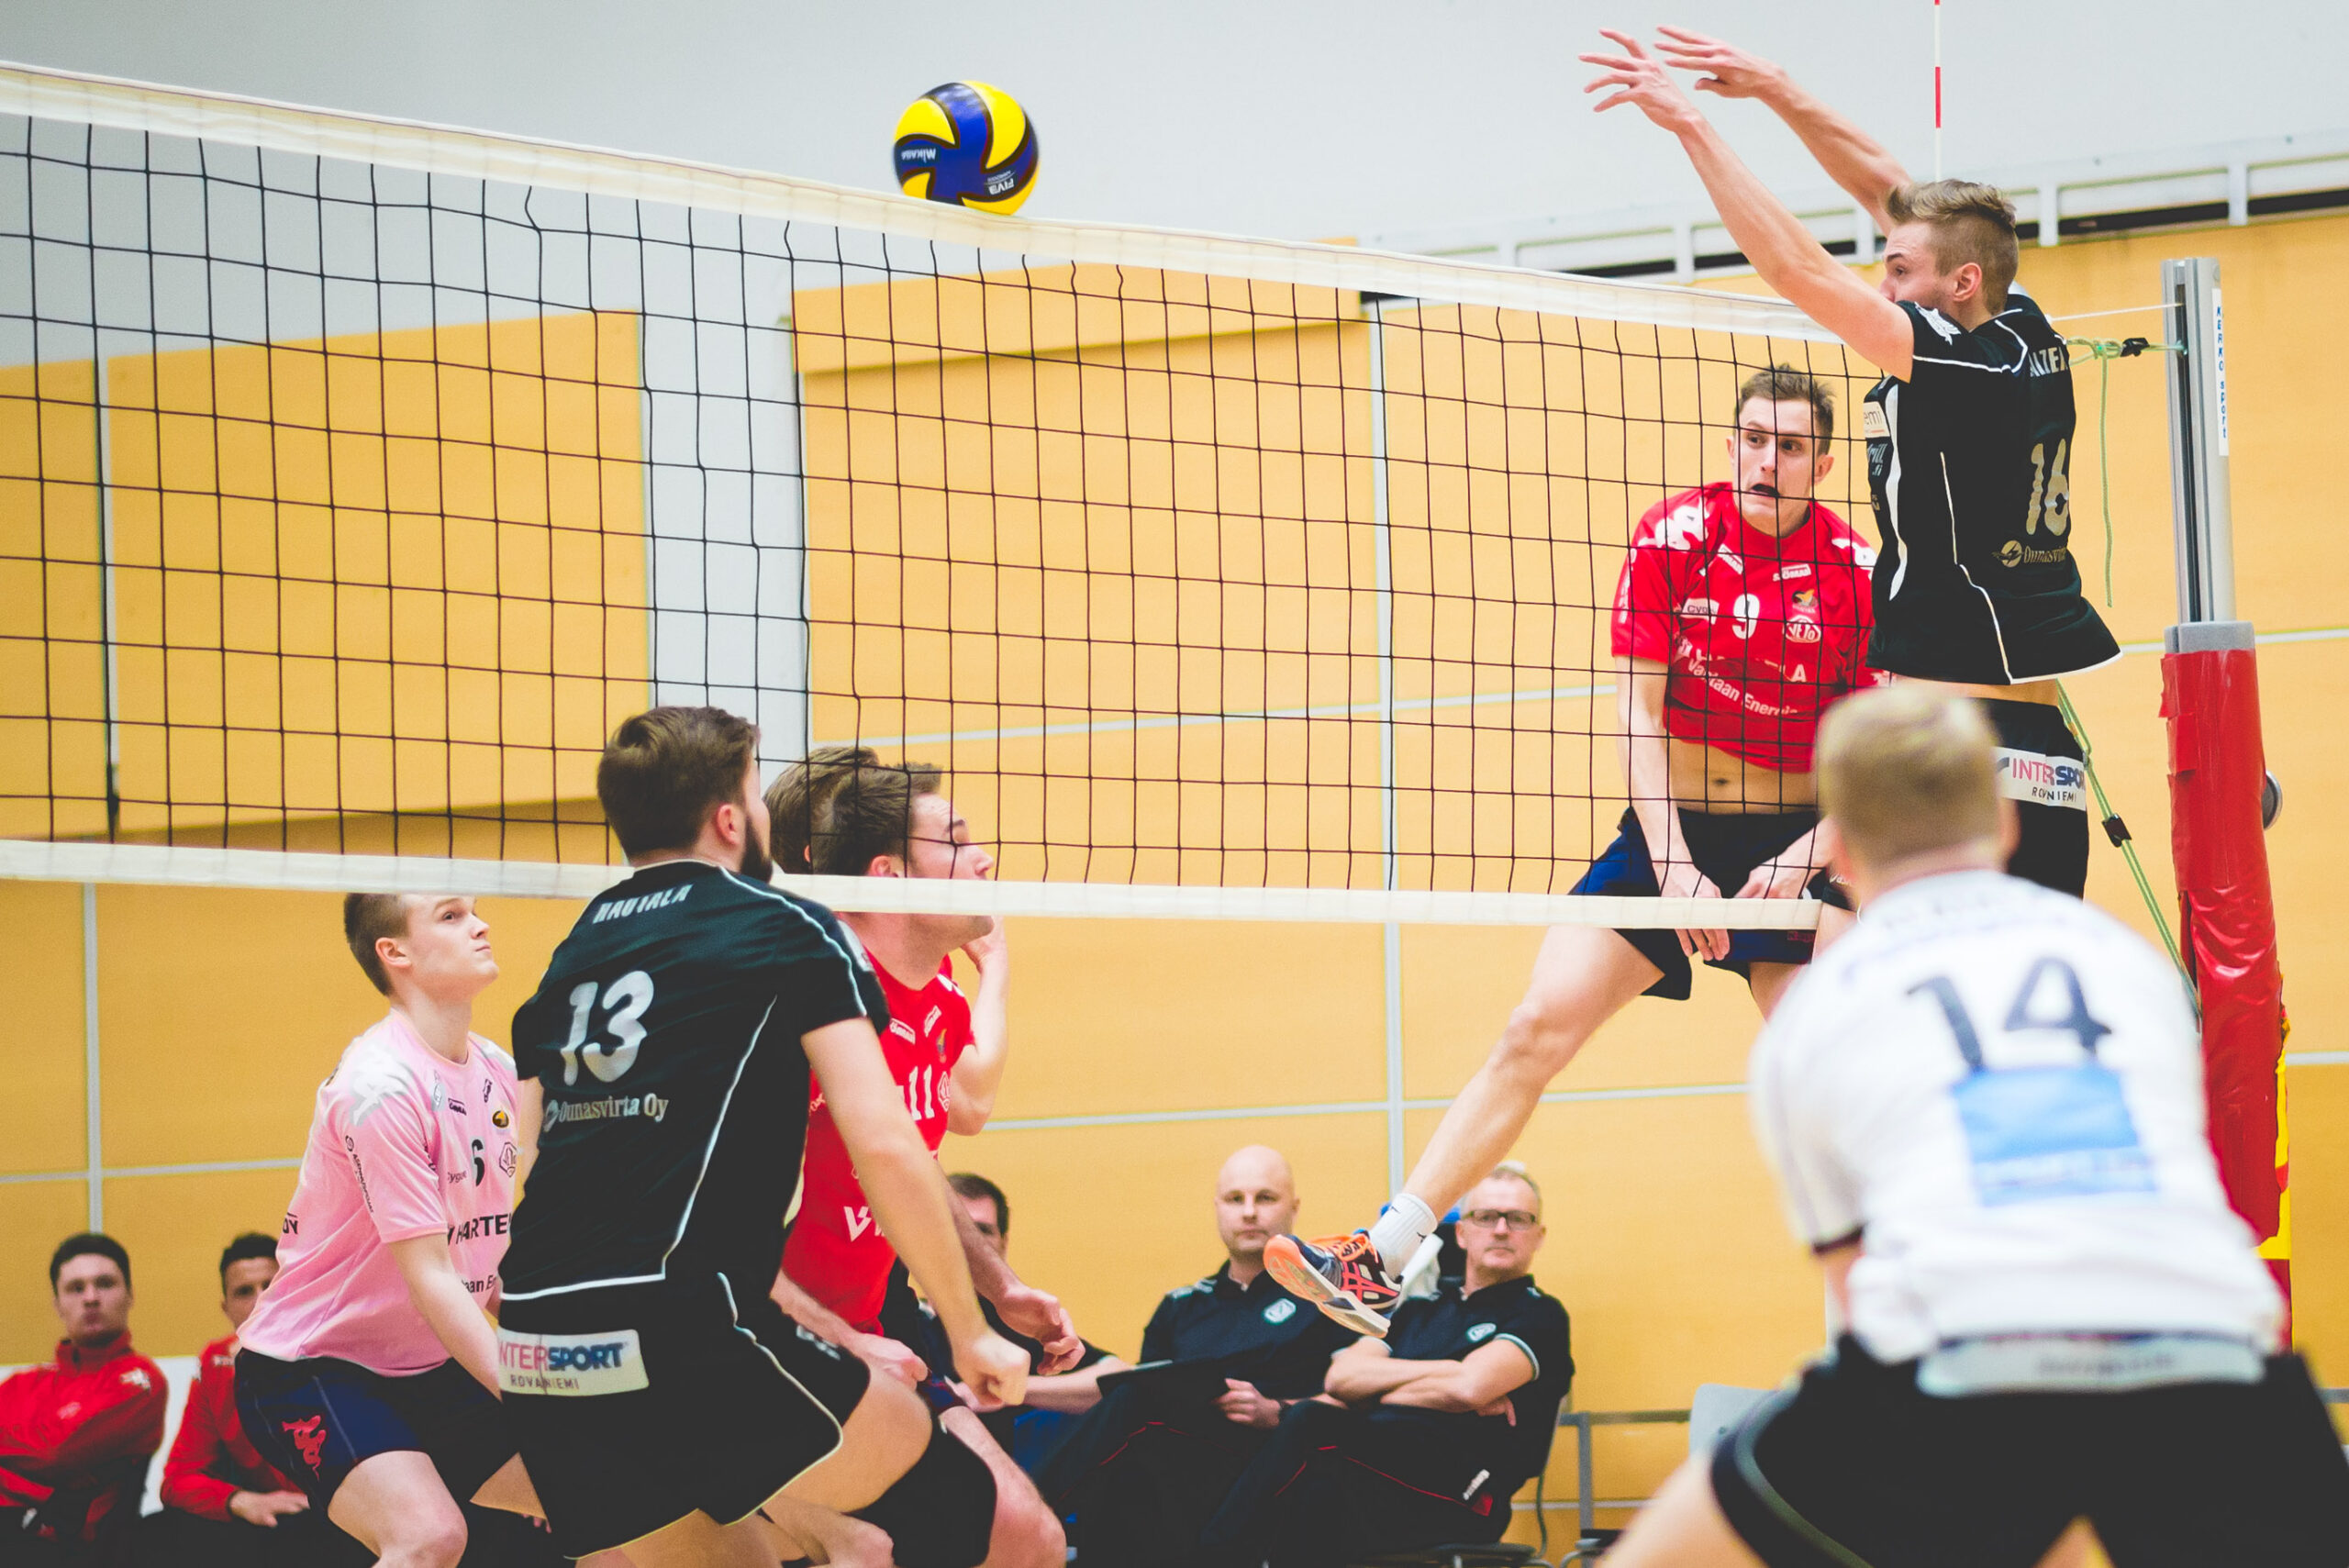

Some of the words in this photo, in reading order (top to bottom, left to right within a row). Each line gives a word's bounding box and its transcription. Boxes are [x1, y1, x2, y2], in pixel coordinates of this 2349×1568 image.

[2025, 438, 2069, 537] 16
[1731, 593, 1761, 639] 9
[561, 971, 655, 1086] 13
[1906, 956, 2112, 1073] 14
[644, 1093, 669, 1122] Oy
[908, 1064, 935, 1121] 11
[471, 1139, 485, 1187] 6
[455, 1213, 512, 1244] HARTE
[499, 1340, 624, 1372] NTERSPORT
